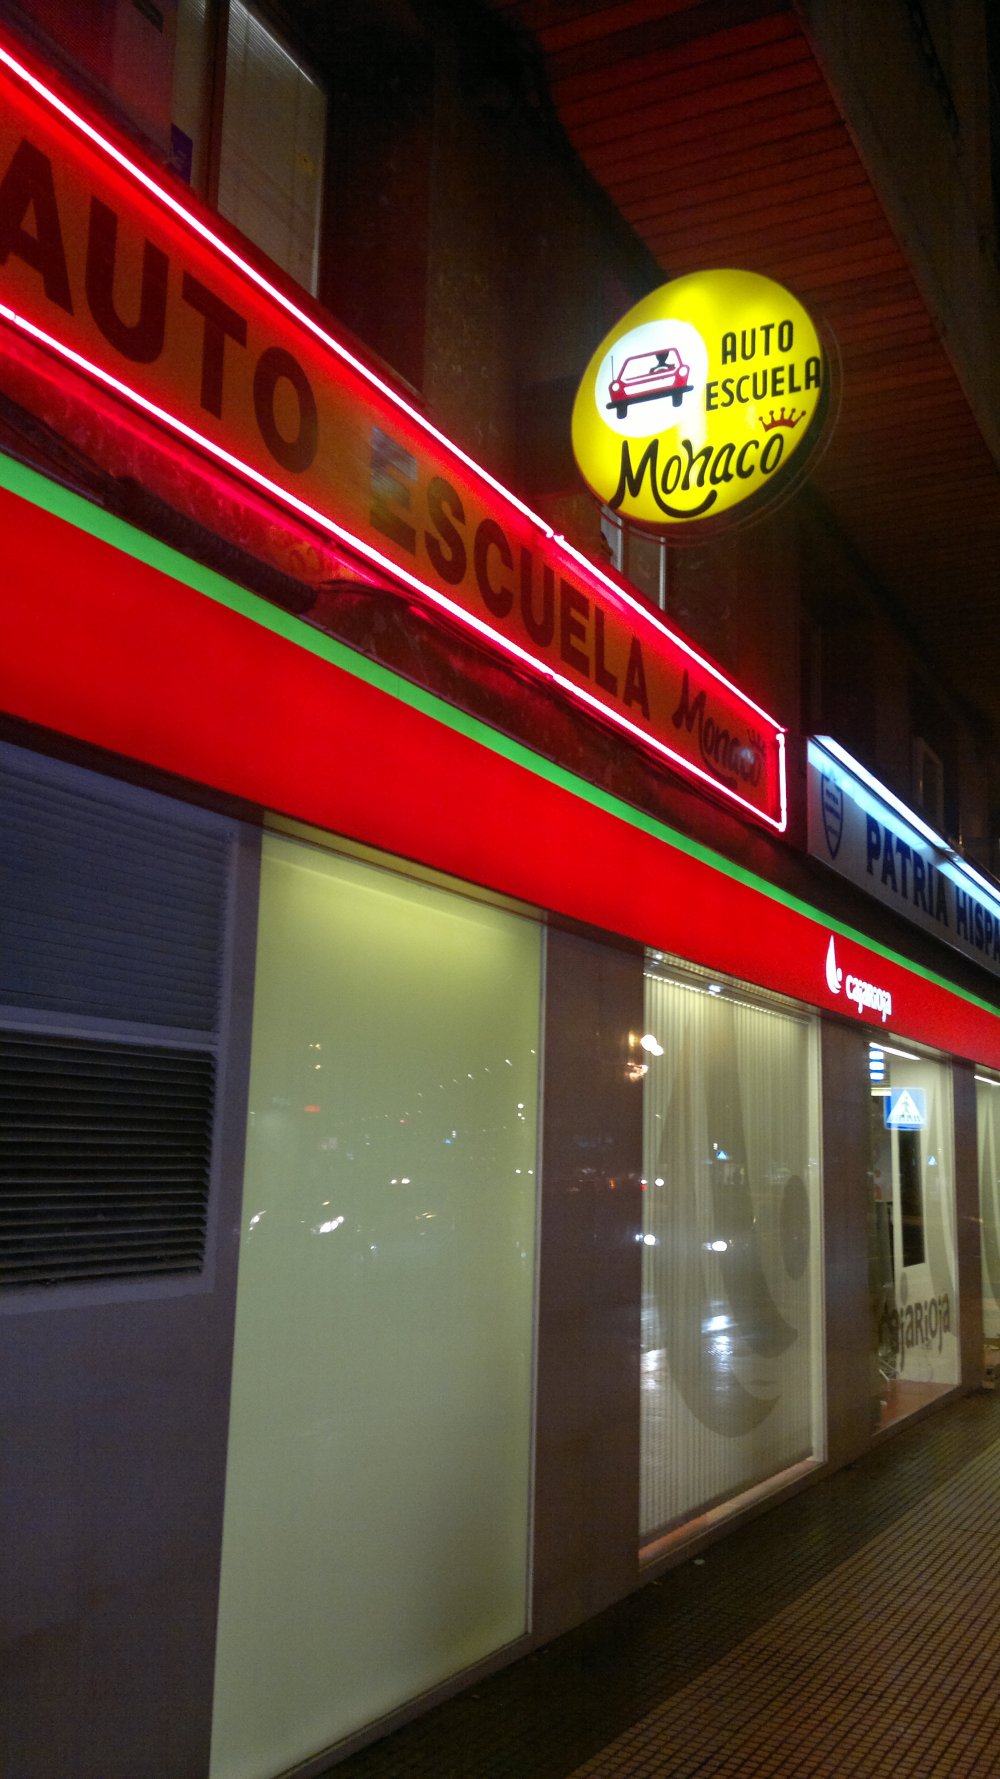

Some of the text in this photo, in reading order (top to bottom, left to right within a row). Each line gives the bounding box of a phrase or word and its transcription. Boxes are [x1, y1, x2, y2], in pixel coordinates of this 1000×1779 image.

[705, 356, 821, 412] ESCUELA
[721, 319, 794, 365] AUTO
[0, 138, 763, 789] AUTO ESCUELA Monaco
[608, 433, 785, 518] Monaco
[866, 812, 949, 927] PATRIA
